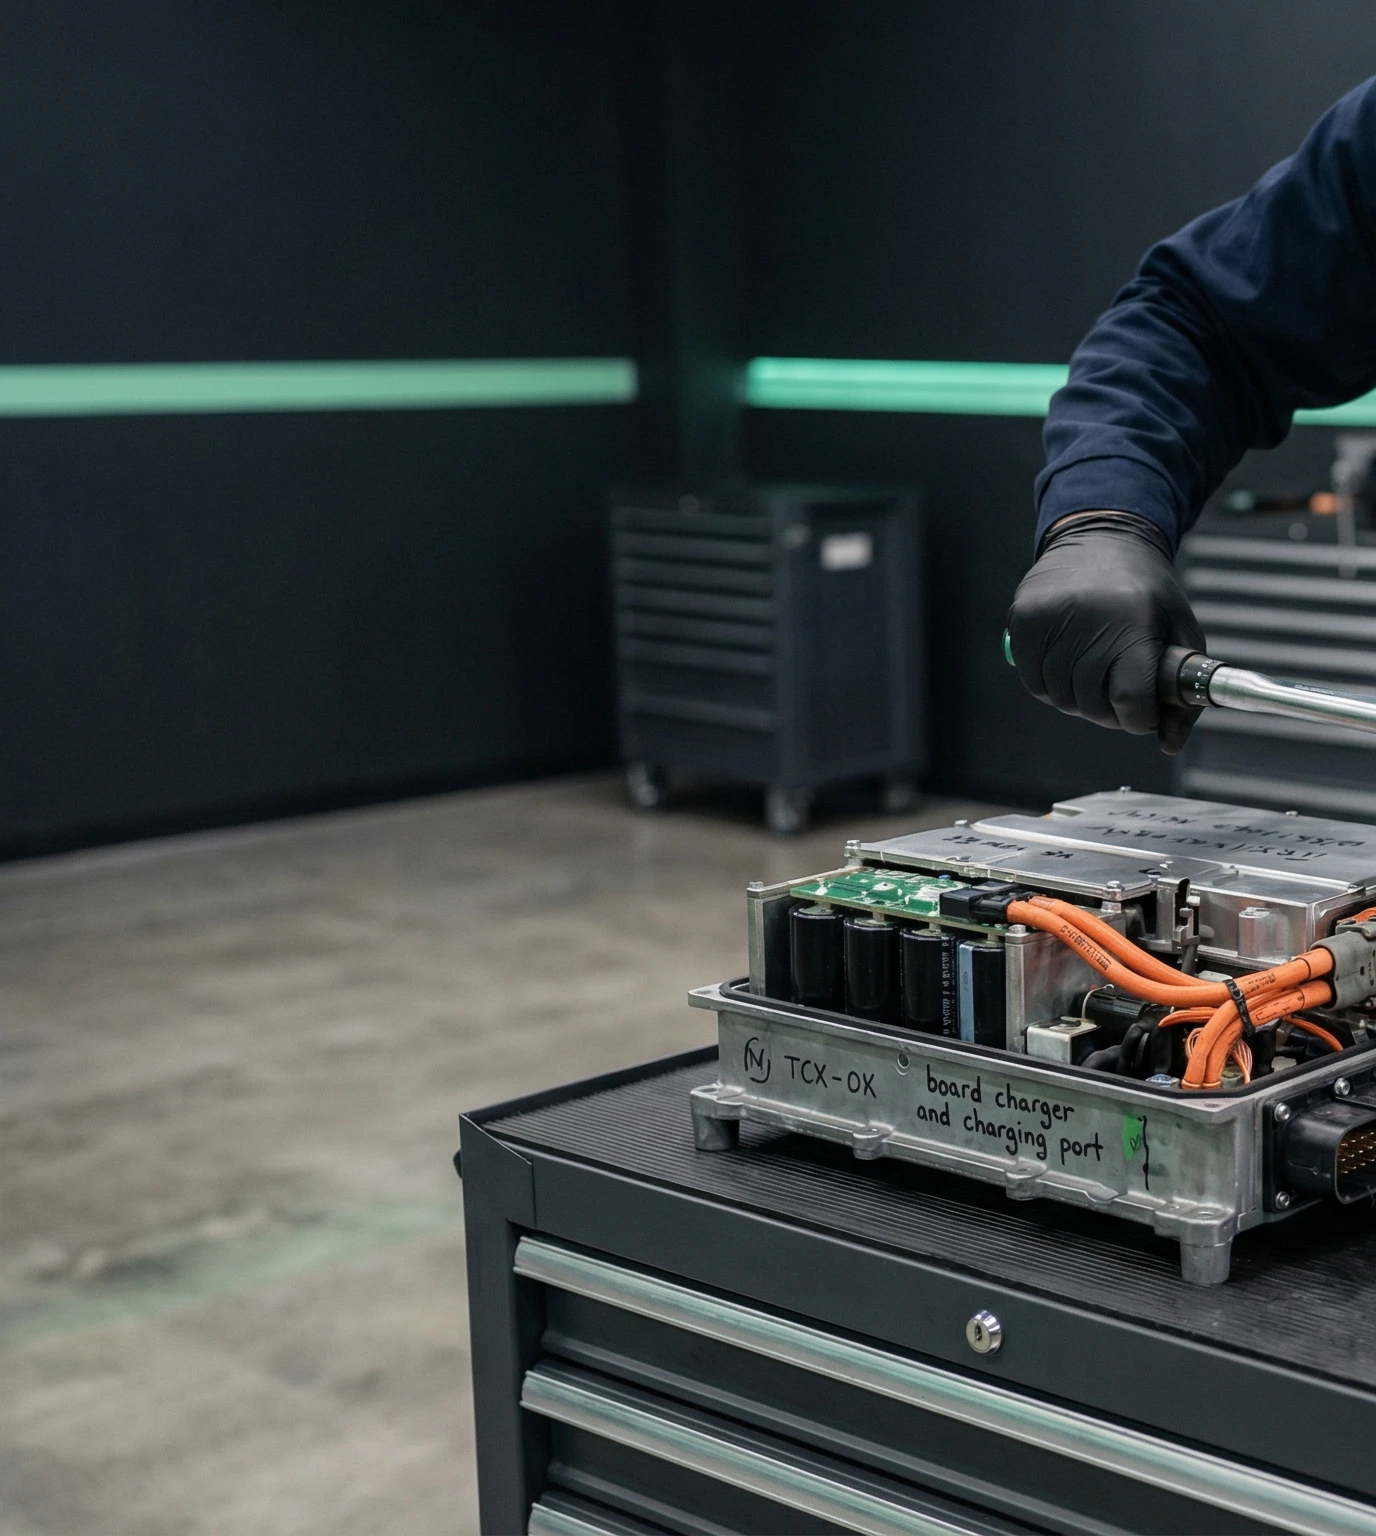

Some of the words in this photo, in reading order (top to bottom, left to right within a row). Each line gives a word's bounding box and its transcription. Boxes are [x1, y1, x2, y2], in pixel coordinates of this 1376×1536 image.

[926, 1063, 982, 1103] board
[995, 1083, 1075, 1130] charger
[916, 1102, 951, 1127] and
[963, 1108, 1048, 1160] charging
[1060, 1132, 1103, 1166] port
